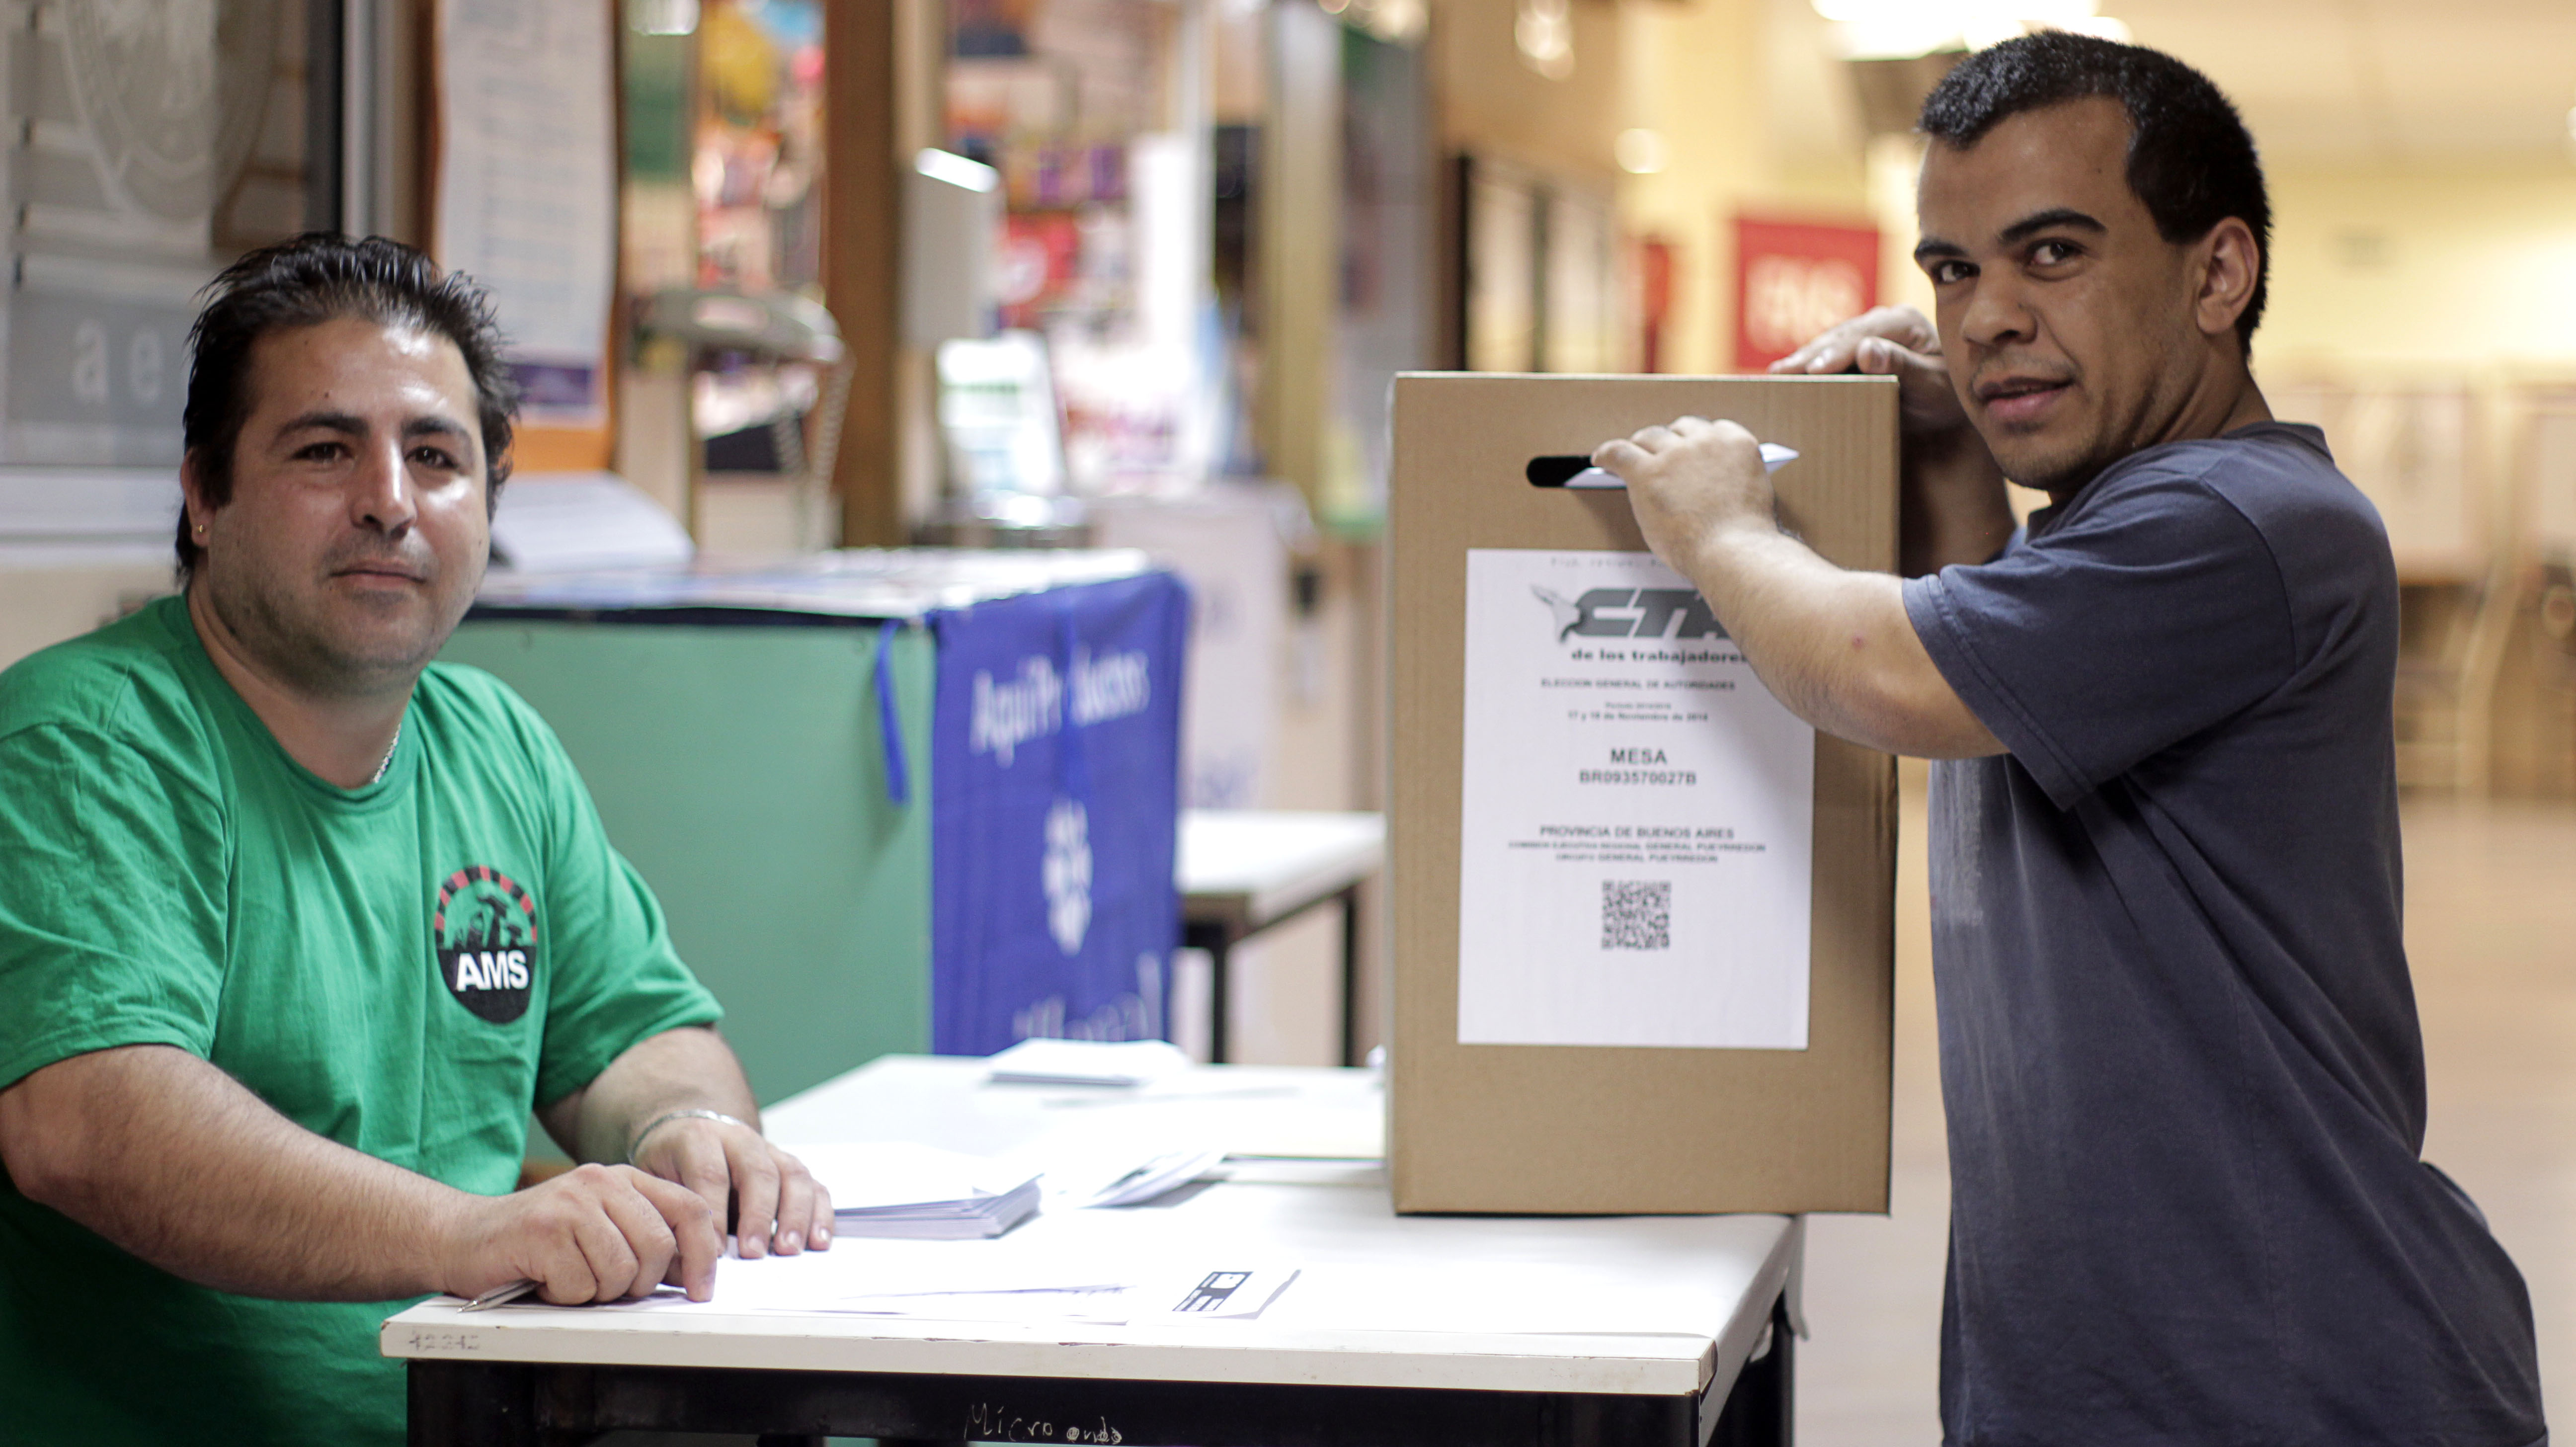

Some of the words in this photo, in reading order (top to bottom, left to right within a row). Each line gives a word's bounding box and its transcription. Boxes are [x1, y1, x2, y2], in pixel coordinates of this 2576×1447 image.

[1572, 649, 1593, 660] de
[1600, 649, 1625, 661] los
[1596, 679, 1643, 689] GENERAL
[1647, 680, 1659, 689] DE
[1663, 681, 1735, 691] AUTORIDADES
[1610, 748, 1668, 764] MESA
[1540, 825, 1610, 838] PROVINCIA
[1614, 826, 1632, 838] DE
[1637, 826, 1690, 839] BUENOS
[1695, 827, 1735, 839] AIRES
[1645, 842, 1692, 851] GENERAL
[1598, 854, 1645, 862] GENERAL
[456, 950, 530, 992] AMS
[964, 1402, 1053, 1443] Micro
